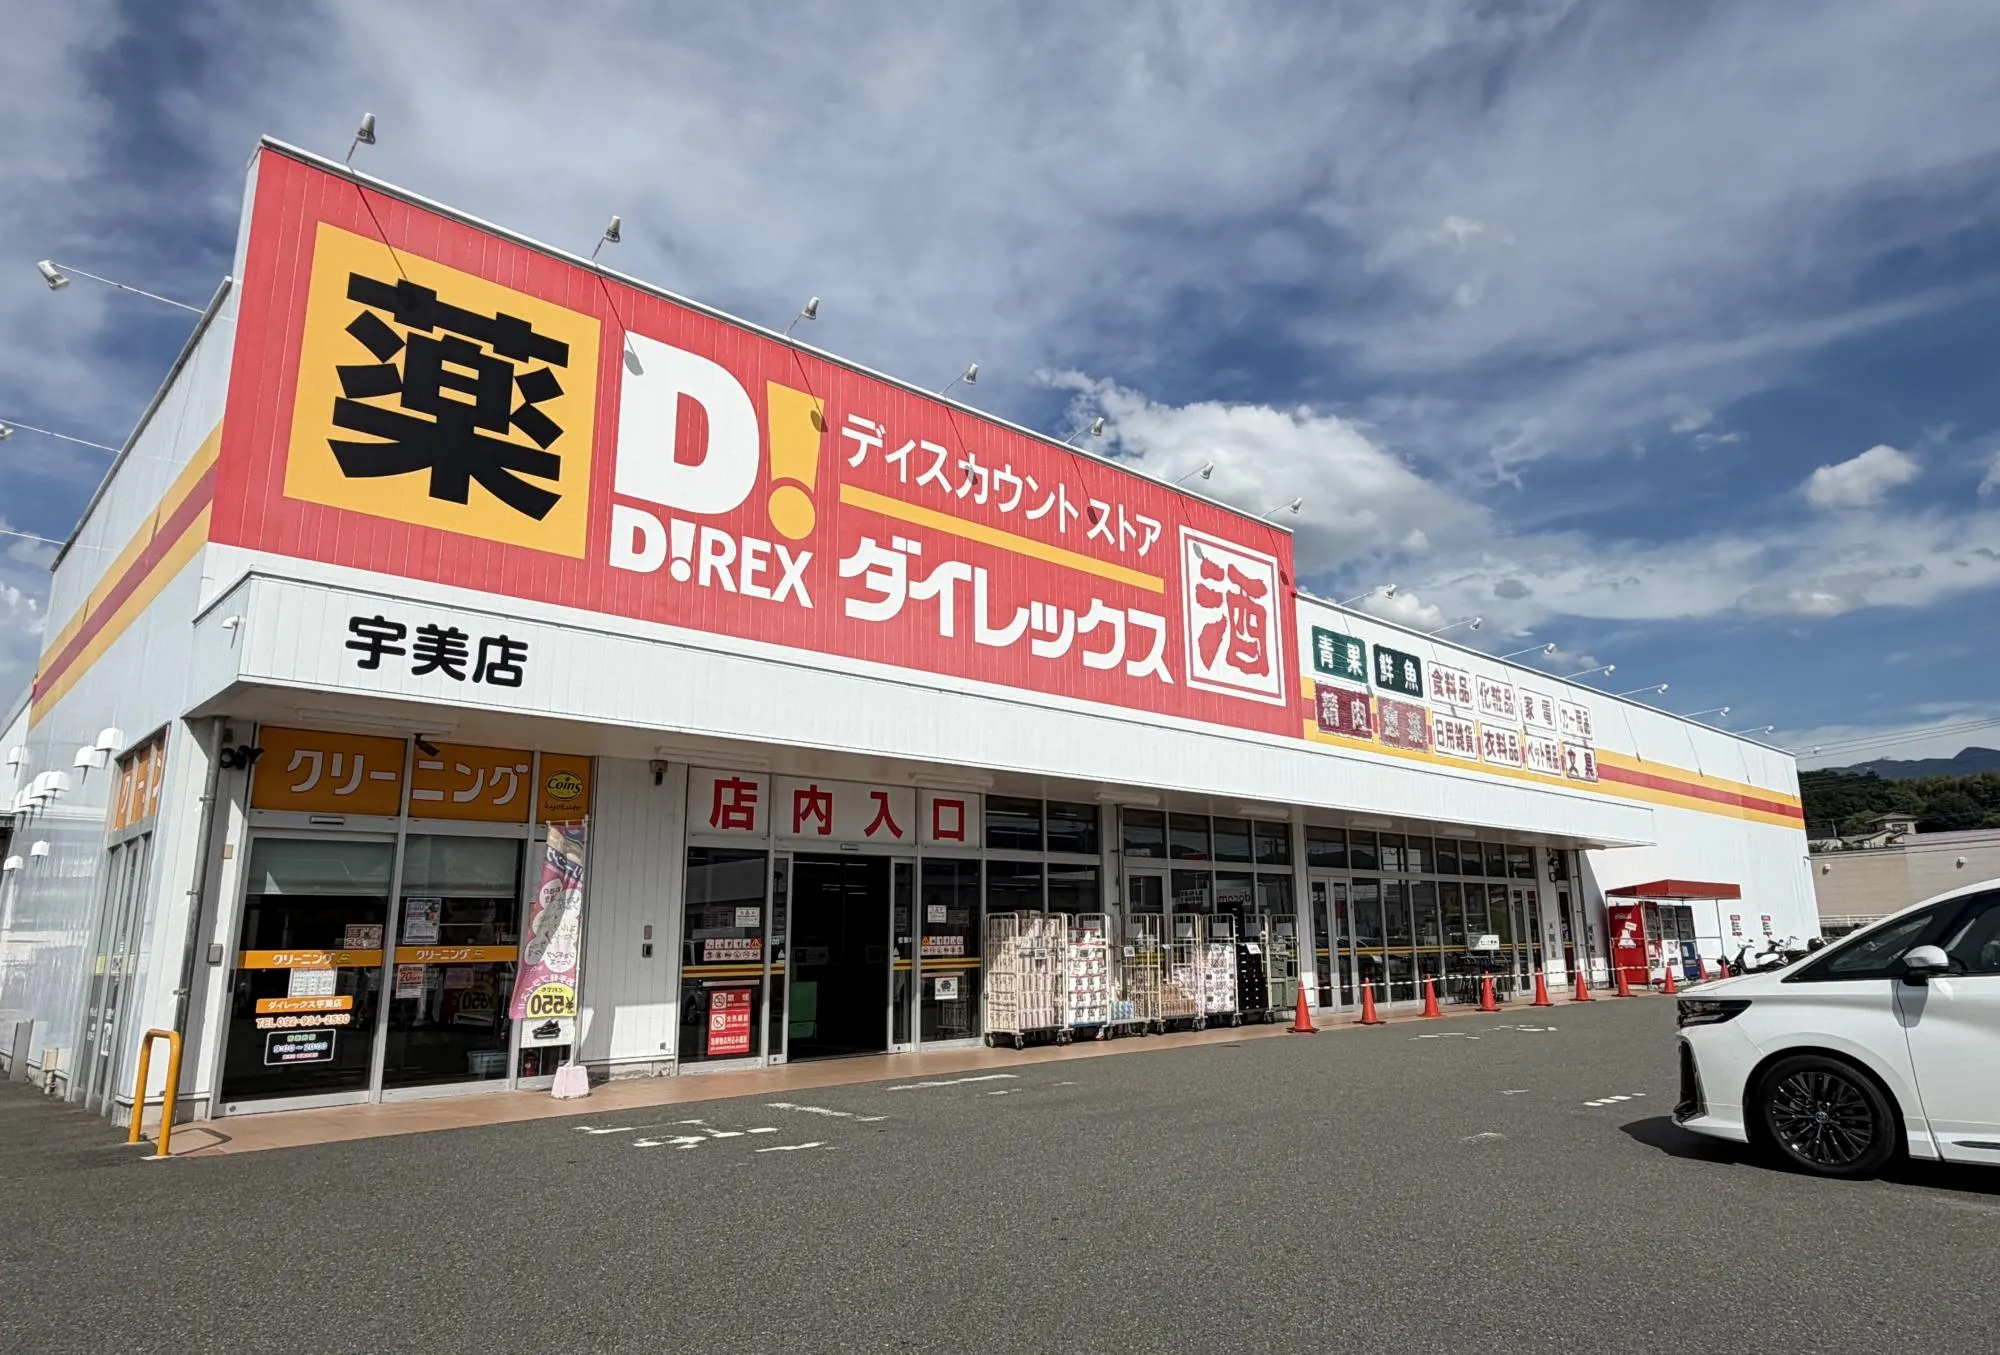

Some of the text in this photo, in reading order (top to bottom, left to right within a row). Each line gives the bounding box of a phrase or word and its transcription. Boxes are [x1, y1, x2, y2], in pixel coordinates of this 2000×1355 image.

[327, 272, 570, 521] 薬
[839, 535, 1174, 684] ダイレックス
[1195, 557, 1269, 677] 酒
[345, 615, 529, 688] 宇美店
[1318, 635, 1363, 676] 青果
[1379, 652, 1419, 692] 鮮魚
[1431, 668, 1470, 704] 食料品
[1321, 691, 1368, 731] 精肉
[1479, 681, 1514, 715] 化粧品
[1524, 696, 1553, 725] 家電
[1435, 719, 1475, 753] 日用雑貨
[1484, 730, 1520, 762] 衣料品
[287, 749, 528, 805] クリーニング
[1566, 748, 1594, 778] 文具
[547, 776, 582, 793] Coins
[545, 801, 582, 812] kyokuto
[273, 952, 335, 965] クリーニング
[416, 949, 470, 960] クリーニング
